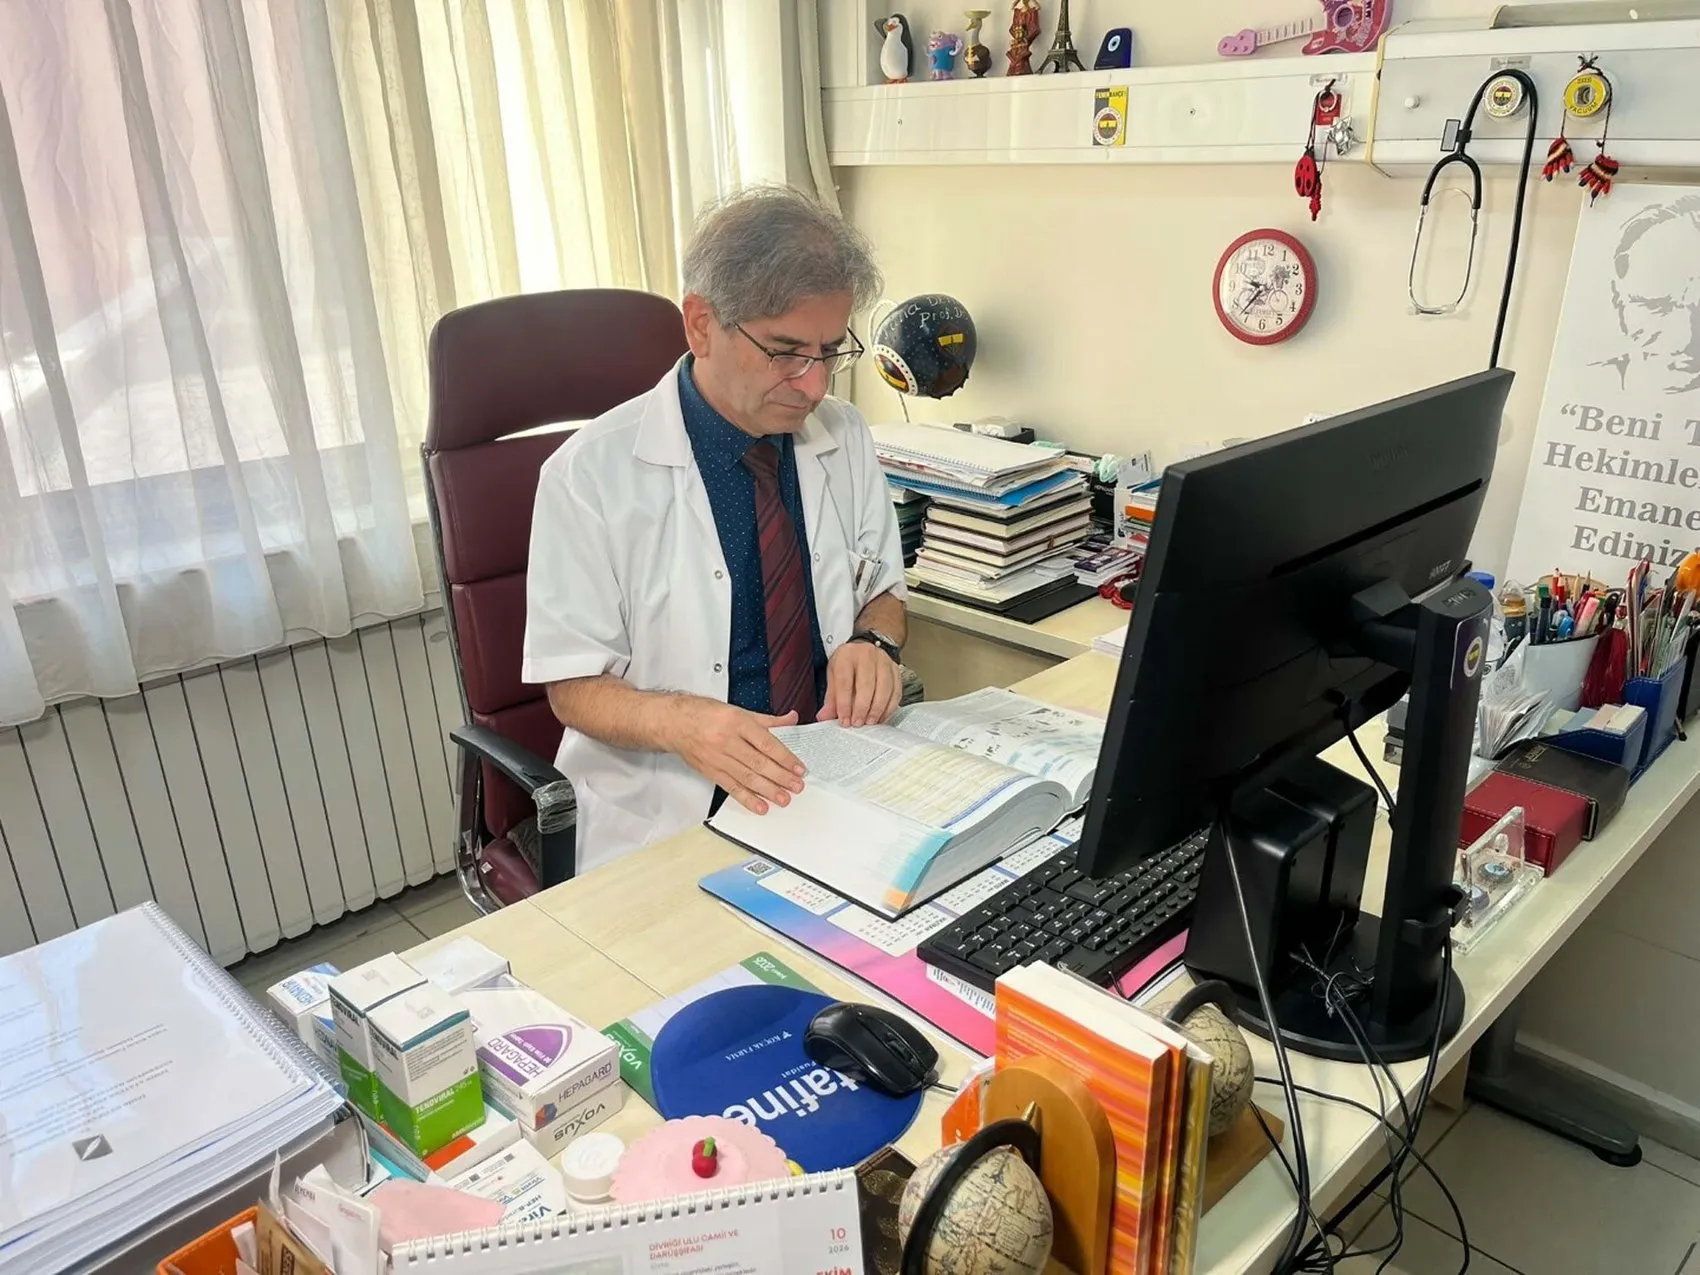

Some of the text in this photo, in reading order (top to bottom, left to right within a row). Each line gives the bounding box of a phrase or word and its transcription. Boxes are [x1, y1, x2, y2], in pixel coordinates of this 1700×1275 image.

[1569, 102, 1599, 114] VACUUM
[1247, 250, 1258, 261] 11
[1263, 244, 1275, 256] 12
[1282, 250, 1287, 261] 1
[1292, 264, 1300, 276] 2
[1295, 283, 1303, 295] 3
[1289, 302, 1297, 313] 4
[1244, 312, 1251, 323] 7
[1276, 314, 1284, 326] 5
[1259, 319, 1266, 330] 6
[1561, 403, 1663, 441] “Beni
[1543, 441, 1700, 489] Hekimle
[725, 1035, 781, 1061] KOÇAK FARMA
[486, 1037, 546, 1079] HEPAGARD
[558, 1061, 613, 1103] HEPAGARD
[415, 1087, 455, 1114] TENOVIRAL
[722, 1065, 860, 1126] tafine
[553, 1102, 606, 1141] VOXUS
[682, 1236, 700, 1245] ULU
[727, 1229, 739, 1238] VE
[830, 1227, 847, 1240] 10
[828, 1244, 850, 1255] 2026
